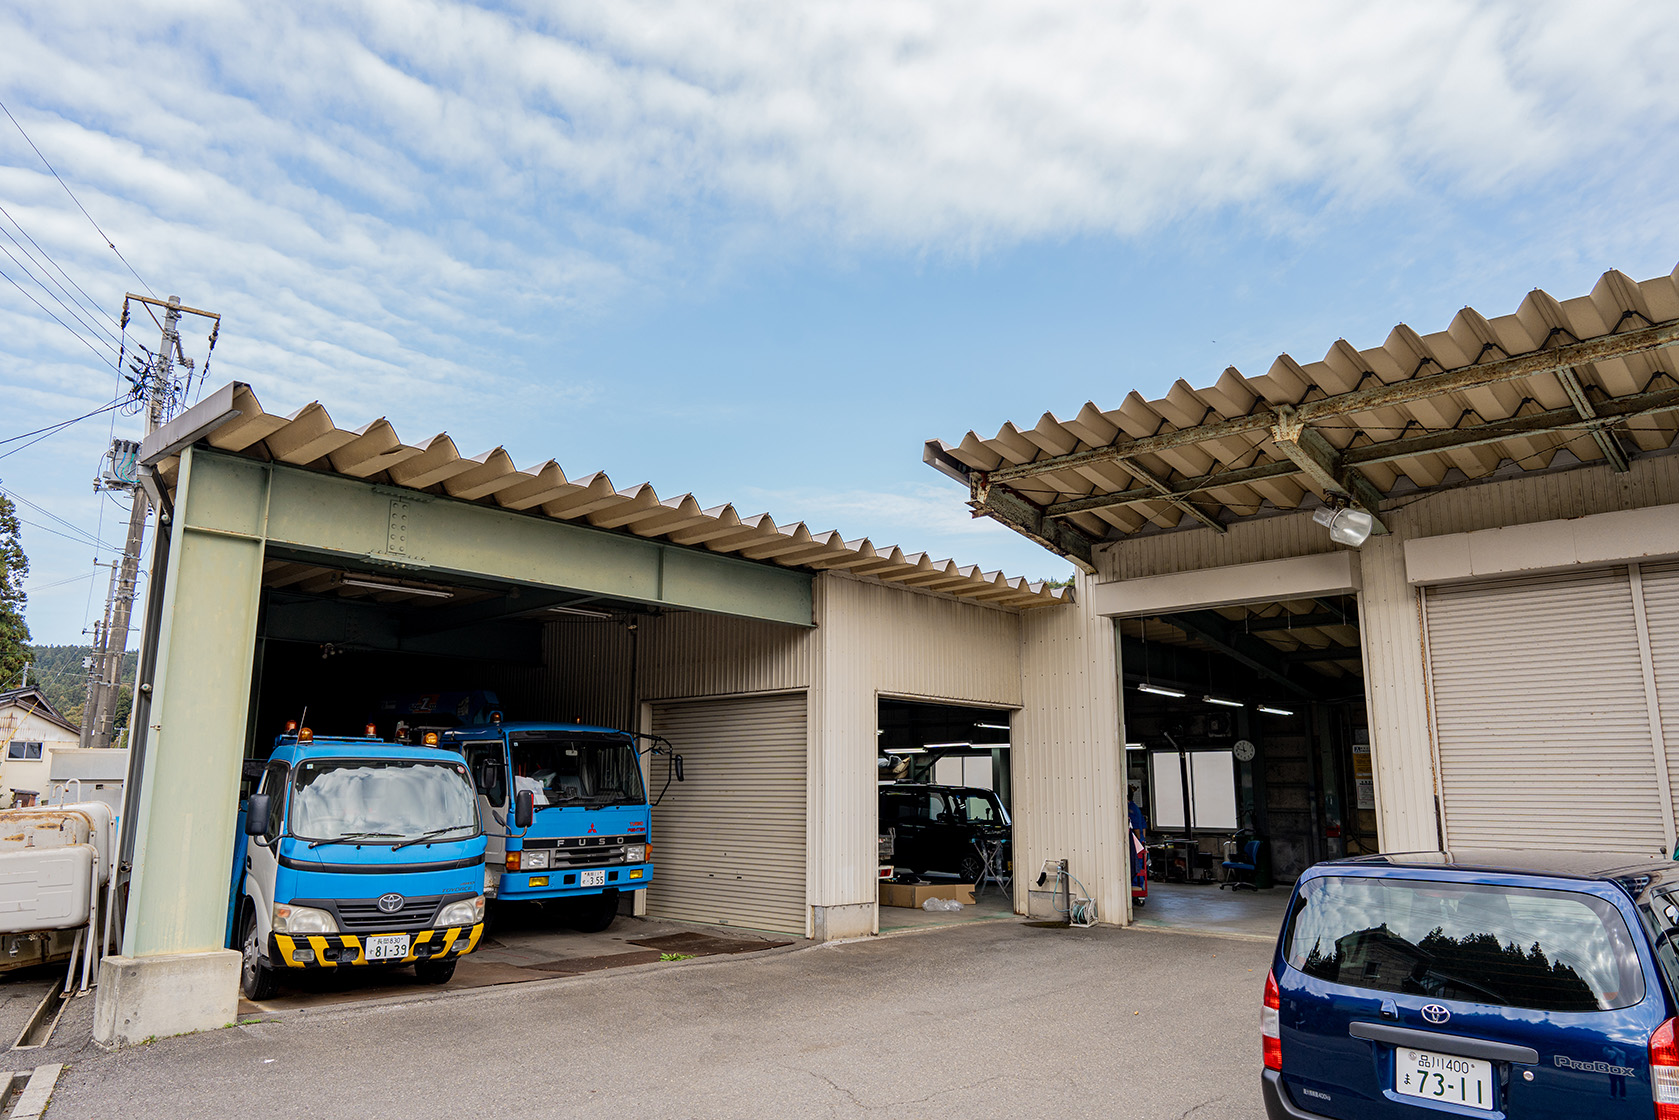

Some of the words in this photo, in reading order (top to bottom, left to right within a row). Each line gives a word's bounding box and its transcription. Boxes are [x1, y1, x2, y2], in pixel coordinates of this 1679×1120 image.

[557, 837, 624, 848] FUSO
[375, 944, 407, 957] 81-39
[1418, 1054, 1469, 1074] 品川400
[1554, 1055, 1635, 1077] ProBox
[1417, 1069, 1483, 1104] 73-11
